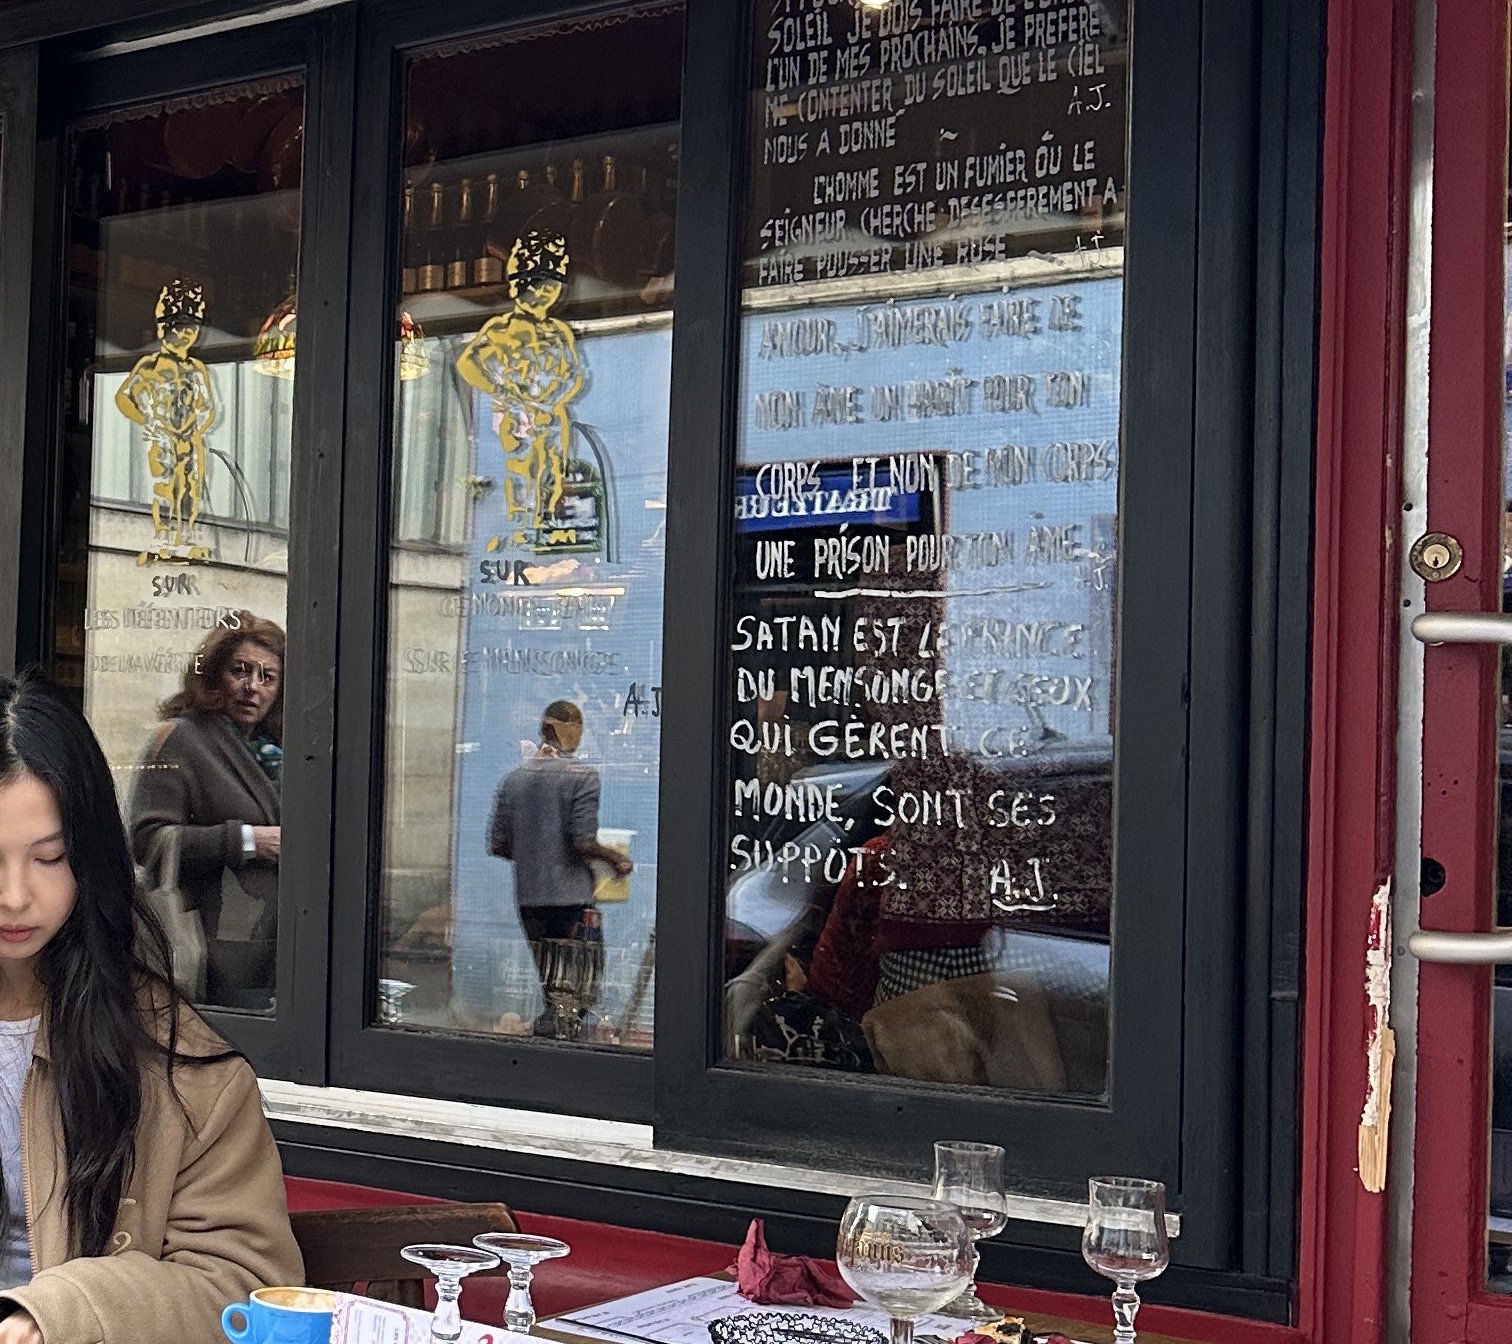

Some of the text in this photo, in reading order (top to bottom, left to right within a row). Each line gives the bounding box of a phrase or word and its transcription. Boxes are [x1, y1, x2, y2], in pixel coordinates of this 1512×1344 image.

[765, 55, 800, 92] L'UN
[808, 50, 828, 85] DE
[835, 43, 871, 81] MES
[992, 14, 1016, 53] JE
[1025, 4, 1100, 49] PREFERE
[767, 8, 832, 55] SOLEIL
[847, 2, 871, 44] JE
[798, 77, 893, 122] CONTENTER
[904, 71, 926, 105] DU
[932, 58, 991, 101] SOLEIL
[997, 52, 1031, 94] QUE
[1039, 48, 1057, 82] LE
[1068, 39, 1105, 77] CIEL
[764, 109, 905, 165] NOUS A DONNÉ
[813, 167, 879, 205] L'HOMME
[894, 162, 927, 196] EST
[936, 159, 958, 191] UN
[964, 143, 1028, 189] FUMIER
[1073, 141, 1095, 171] LE
[760, 208, 847, 250] SEIGNEUR
[861, 201, 936, 238] CHERCHE
[759, 233, 1006, 286] FAIRE POUSSER UNE ROSE
[1049, 293, 1083, 332] DE
[755, 459, 821, 500] CORPS
[852, 455, 882, 497] ET
[889, 452, 935, 494] NON
[946, 451, 984, 490] DE
[480, 559, 531, 586] SUR
[755, 540, 796, 580] UNE
[814, 522, 889, 580] PRISON
[906, 534, 957, 573] POUR
[152, 573, 194, 597] SUR
[730, 615, 842, 653] SATAN
[853, 617, 900, 653] EST
[918, 619, 948, 657] LE
[736, 666, 774, 703] DU
[791, 666, 948, 708] MENSONGE
[730, 715, 794, 757] QUI
[979, 724, 1029, 757] CE
[734, 779, 1057, 831] MONDE, SONT SES
[990, 859, 1059, 901] A.J.
